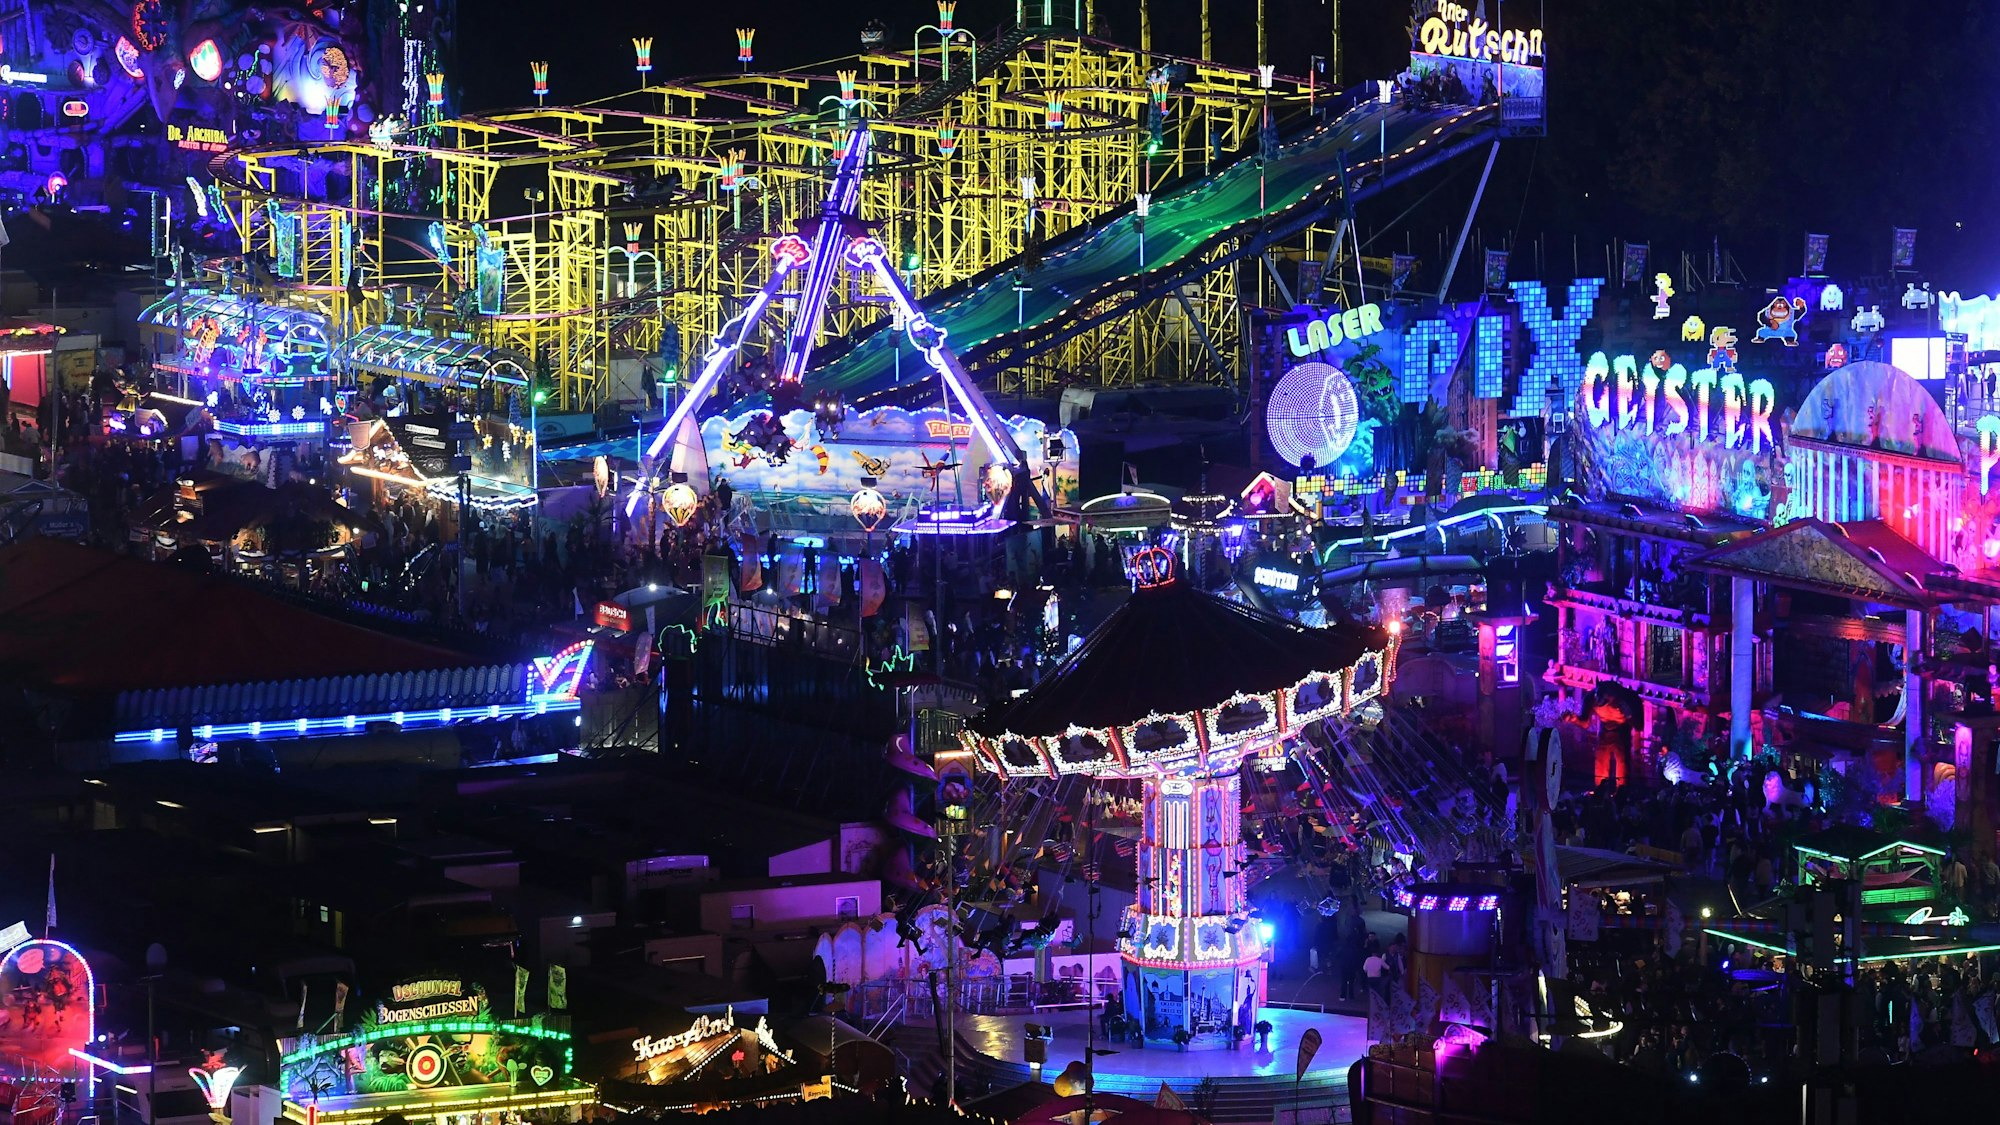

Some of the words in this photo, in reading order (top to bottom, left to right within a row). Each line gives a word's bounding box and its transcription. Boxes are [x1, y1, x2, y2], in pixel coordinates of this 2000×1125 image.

[1420, 16, 1543, 65] Rutschn
[187, 125, 229, 144] ARCHIBAL
[1286, 303, 1386, 357] LASER
[1401, 278, 1605, 418] PIX
[1582, 351, 1776, 456] GEISTER
[930, 423, 950, 435] FLIP
[952, 425, 970, 436] FLY
[392, 980, 462, 1002] DSCHUNGEL
[380, 996, 478, 1023] BOGENSCHIESSEN
